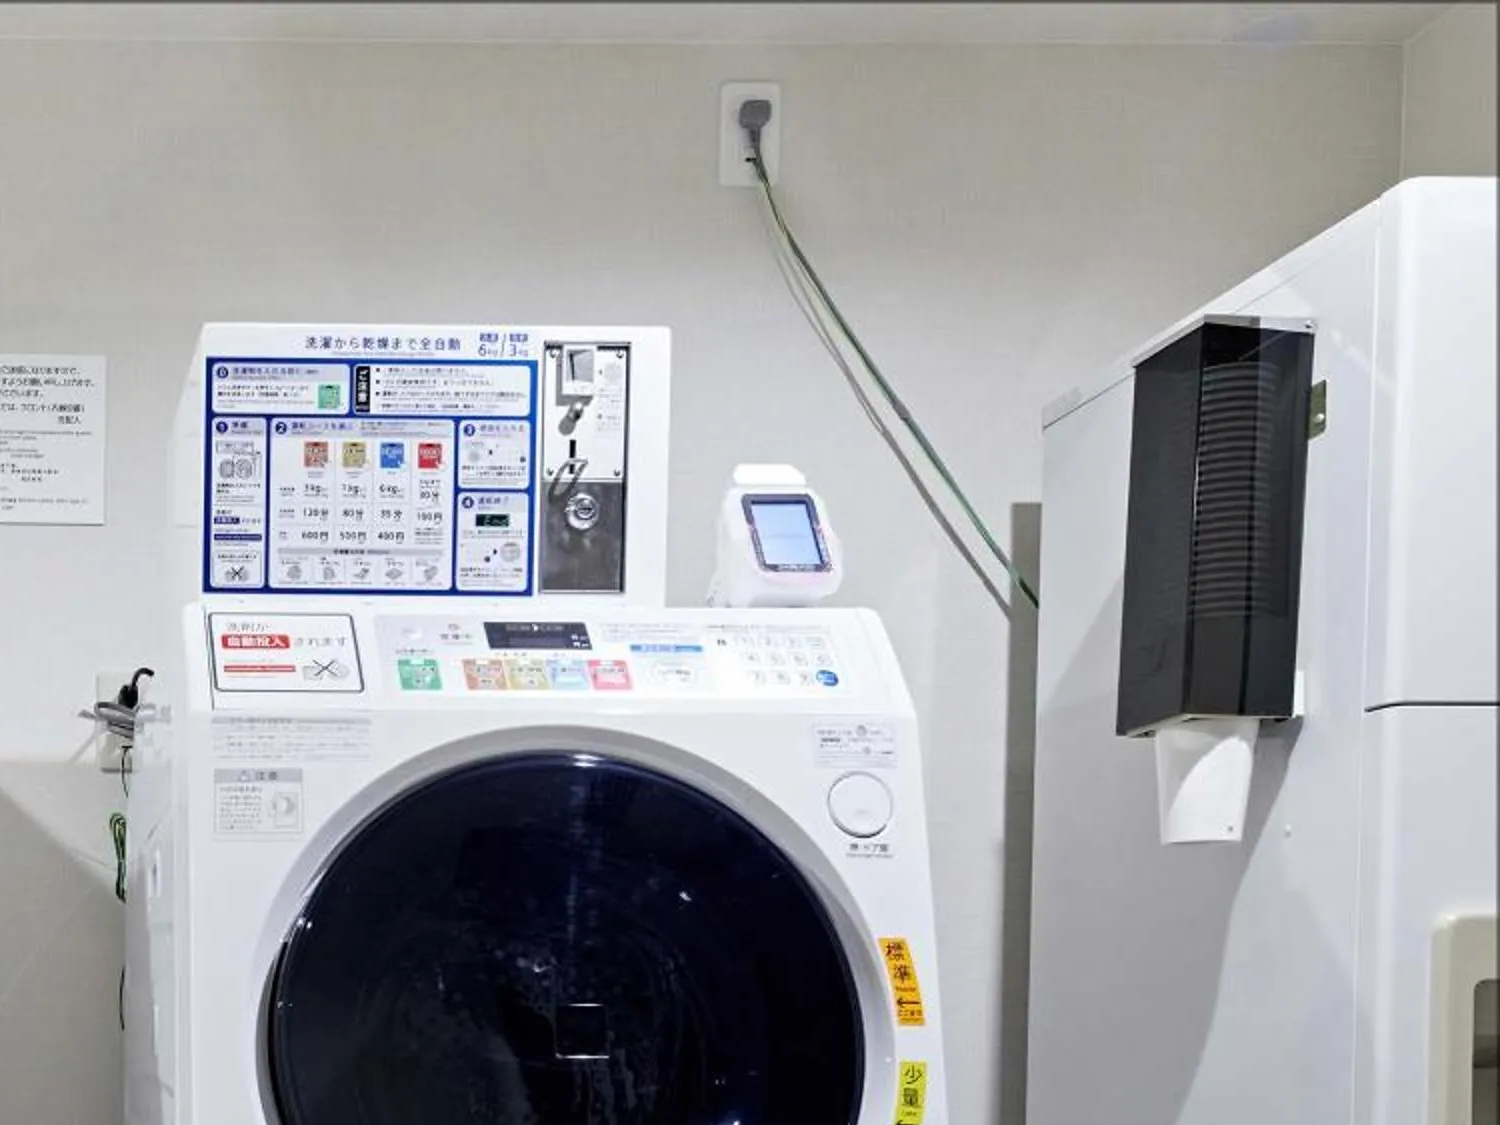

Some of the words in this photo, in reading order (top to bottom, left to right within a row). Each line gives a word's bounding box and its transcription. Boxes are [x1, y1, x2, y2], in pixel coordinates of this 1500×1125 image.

[304, 335, 461, 351] 洗濯から乾燥まで全自動
[885, 942, 911, 984] 標準
[903, 1065, 923, 1108] 少量
